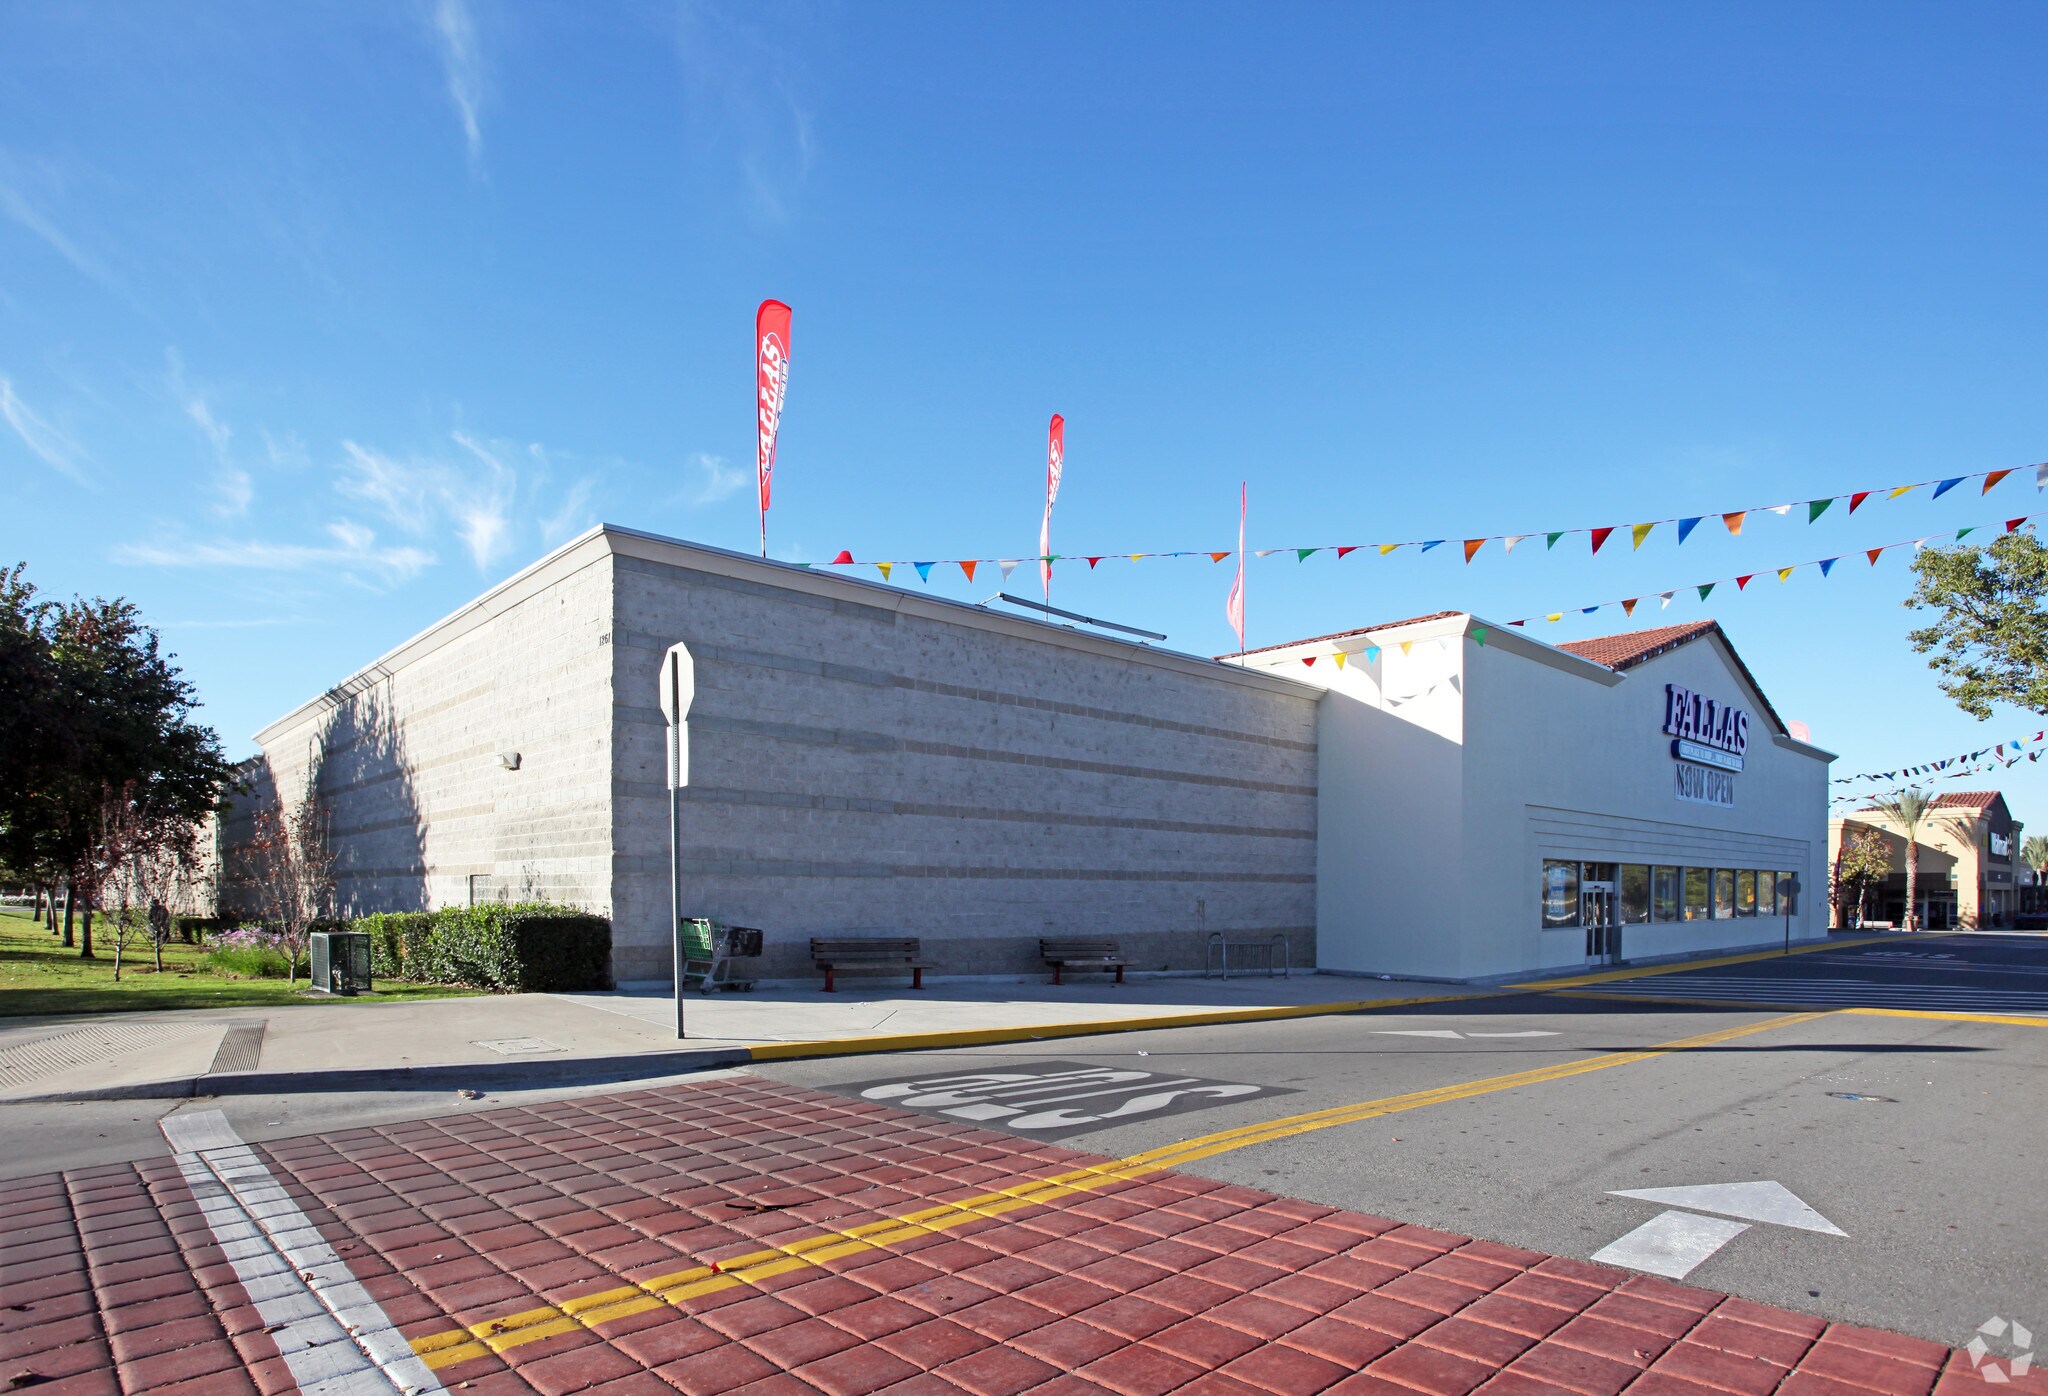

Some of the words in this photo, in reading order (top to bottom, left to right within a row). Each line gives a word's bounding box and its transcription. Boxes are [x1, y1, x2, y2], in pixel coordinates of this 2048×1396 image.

[1663, 684, 1748, 756] FALLAS
[1676, 763, 1705, 800] NOW
[1707, 771, 1733, 804] OPEN
[1862, 951, 1956, 959] STOP
[860, 1067, 1262, 1129] STOP
